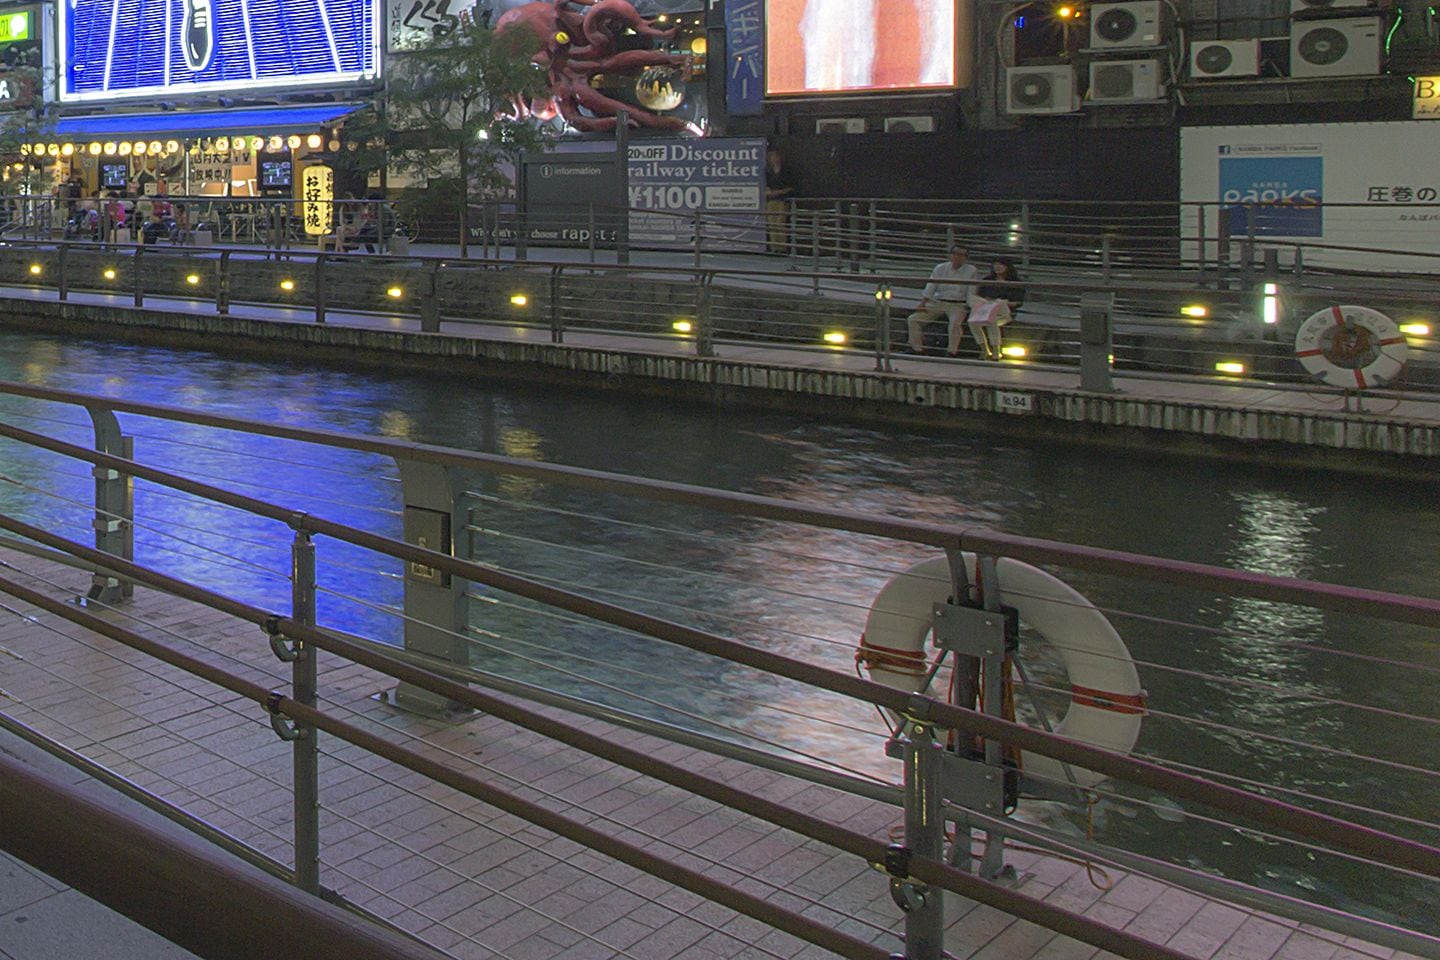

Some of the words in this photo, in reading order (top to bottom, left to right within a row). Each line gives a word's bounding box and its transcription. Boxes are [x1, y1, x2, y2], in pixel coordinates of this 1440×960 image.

[1416, 79, 1440, 99] B
[670, 144, 760, 161] Discount
[554, 166, 602, 176] information
[627, 161, 697, 182] railway
[701, 161, 760, 178] ticket
[305, 175, 321, 228] お好み焼
[627, 186, 704, 210] ¥1,100
[1367, 186, 1438, 203] 圧巻の
